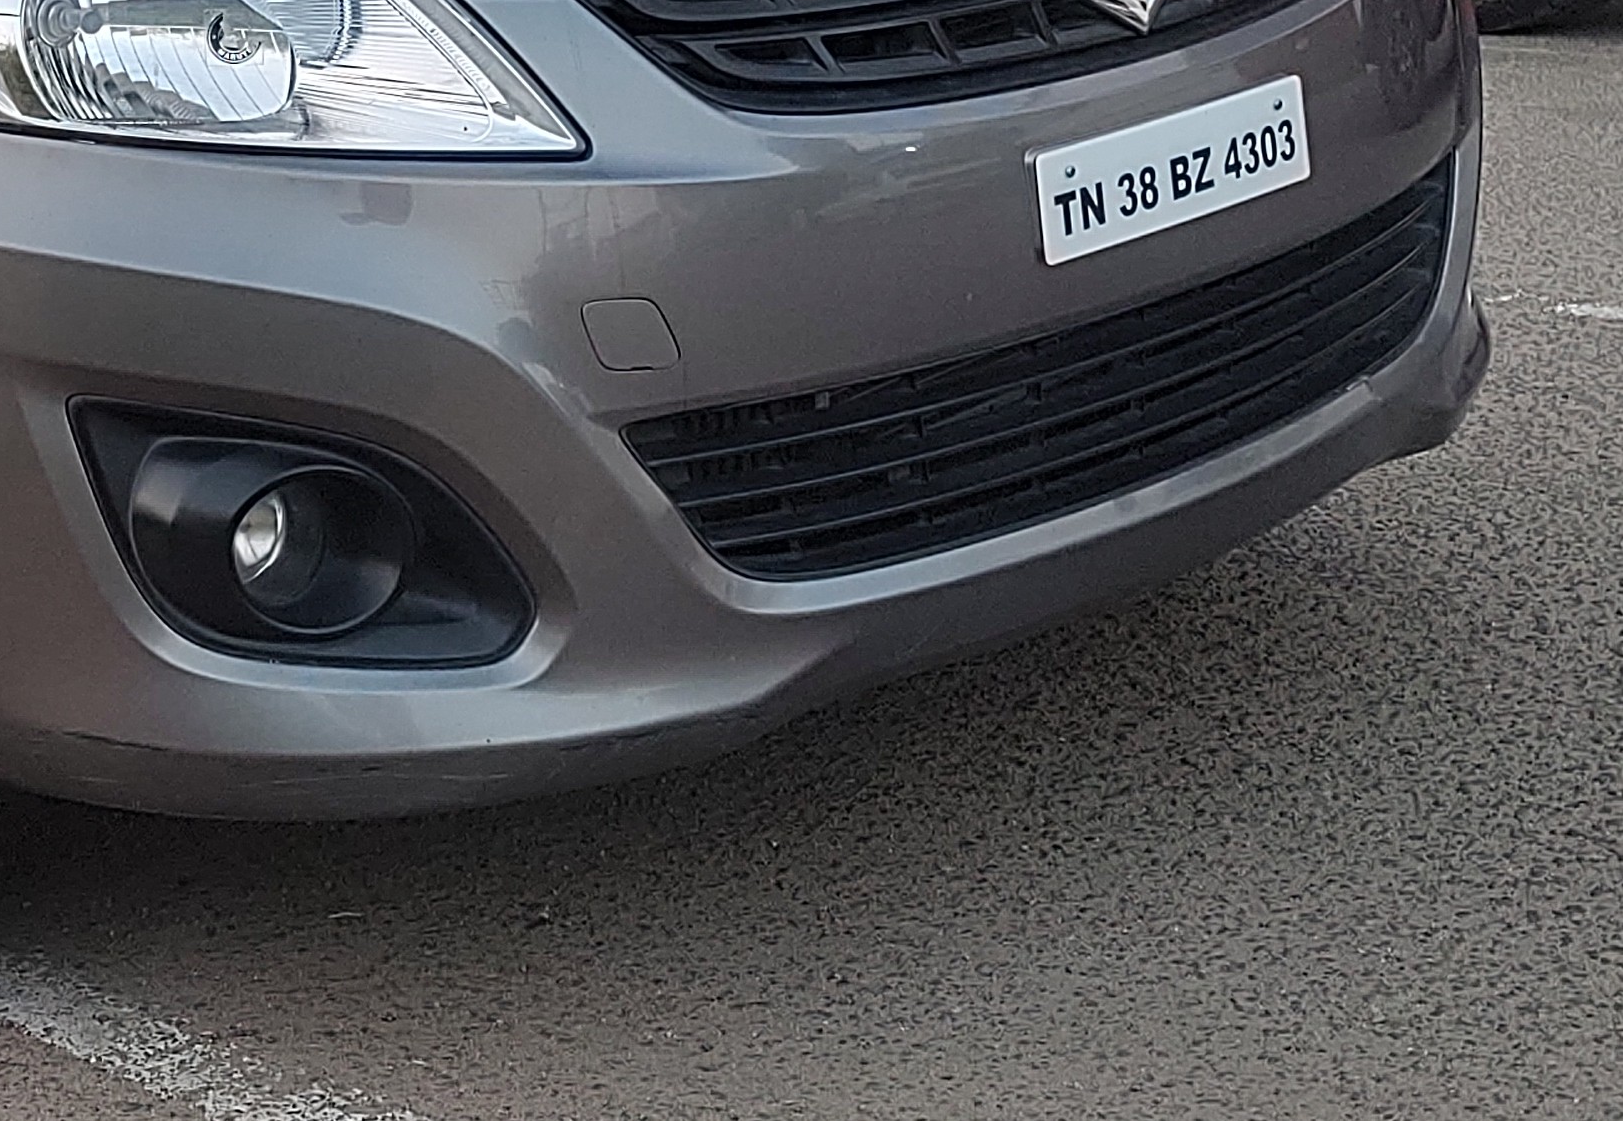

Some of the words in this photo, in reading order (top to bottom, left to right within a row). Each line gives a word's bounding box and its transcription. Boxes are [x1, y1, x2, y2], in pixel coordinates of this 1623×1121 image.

[1054, 182, 1107, 236] TN
[1117, 166, 1159, 216] 38
[1169, 146, 1215, 201] BZ
[1224, 119, 1296, 179] 4303
